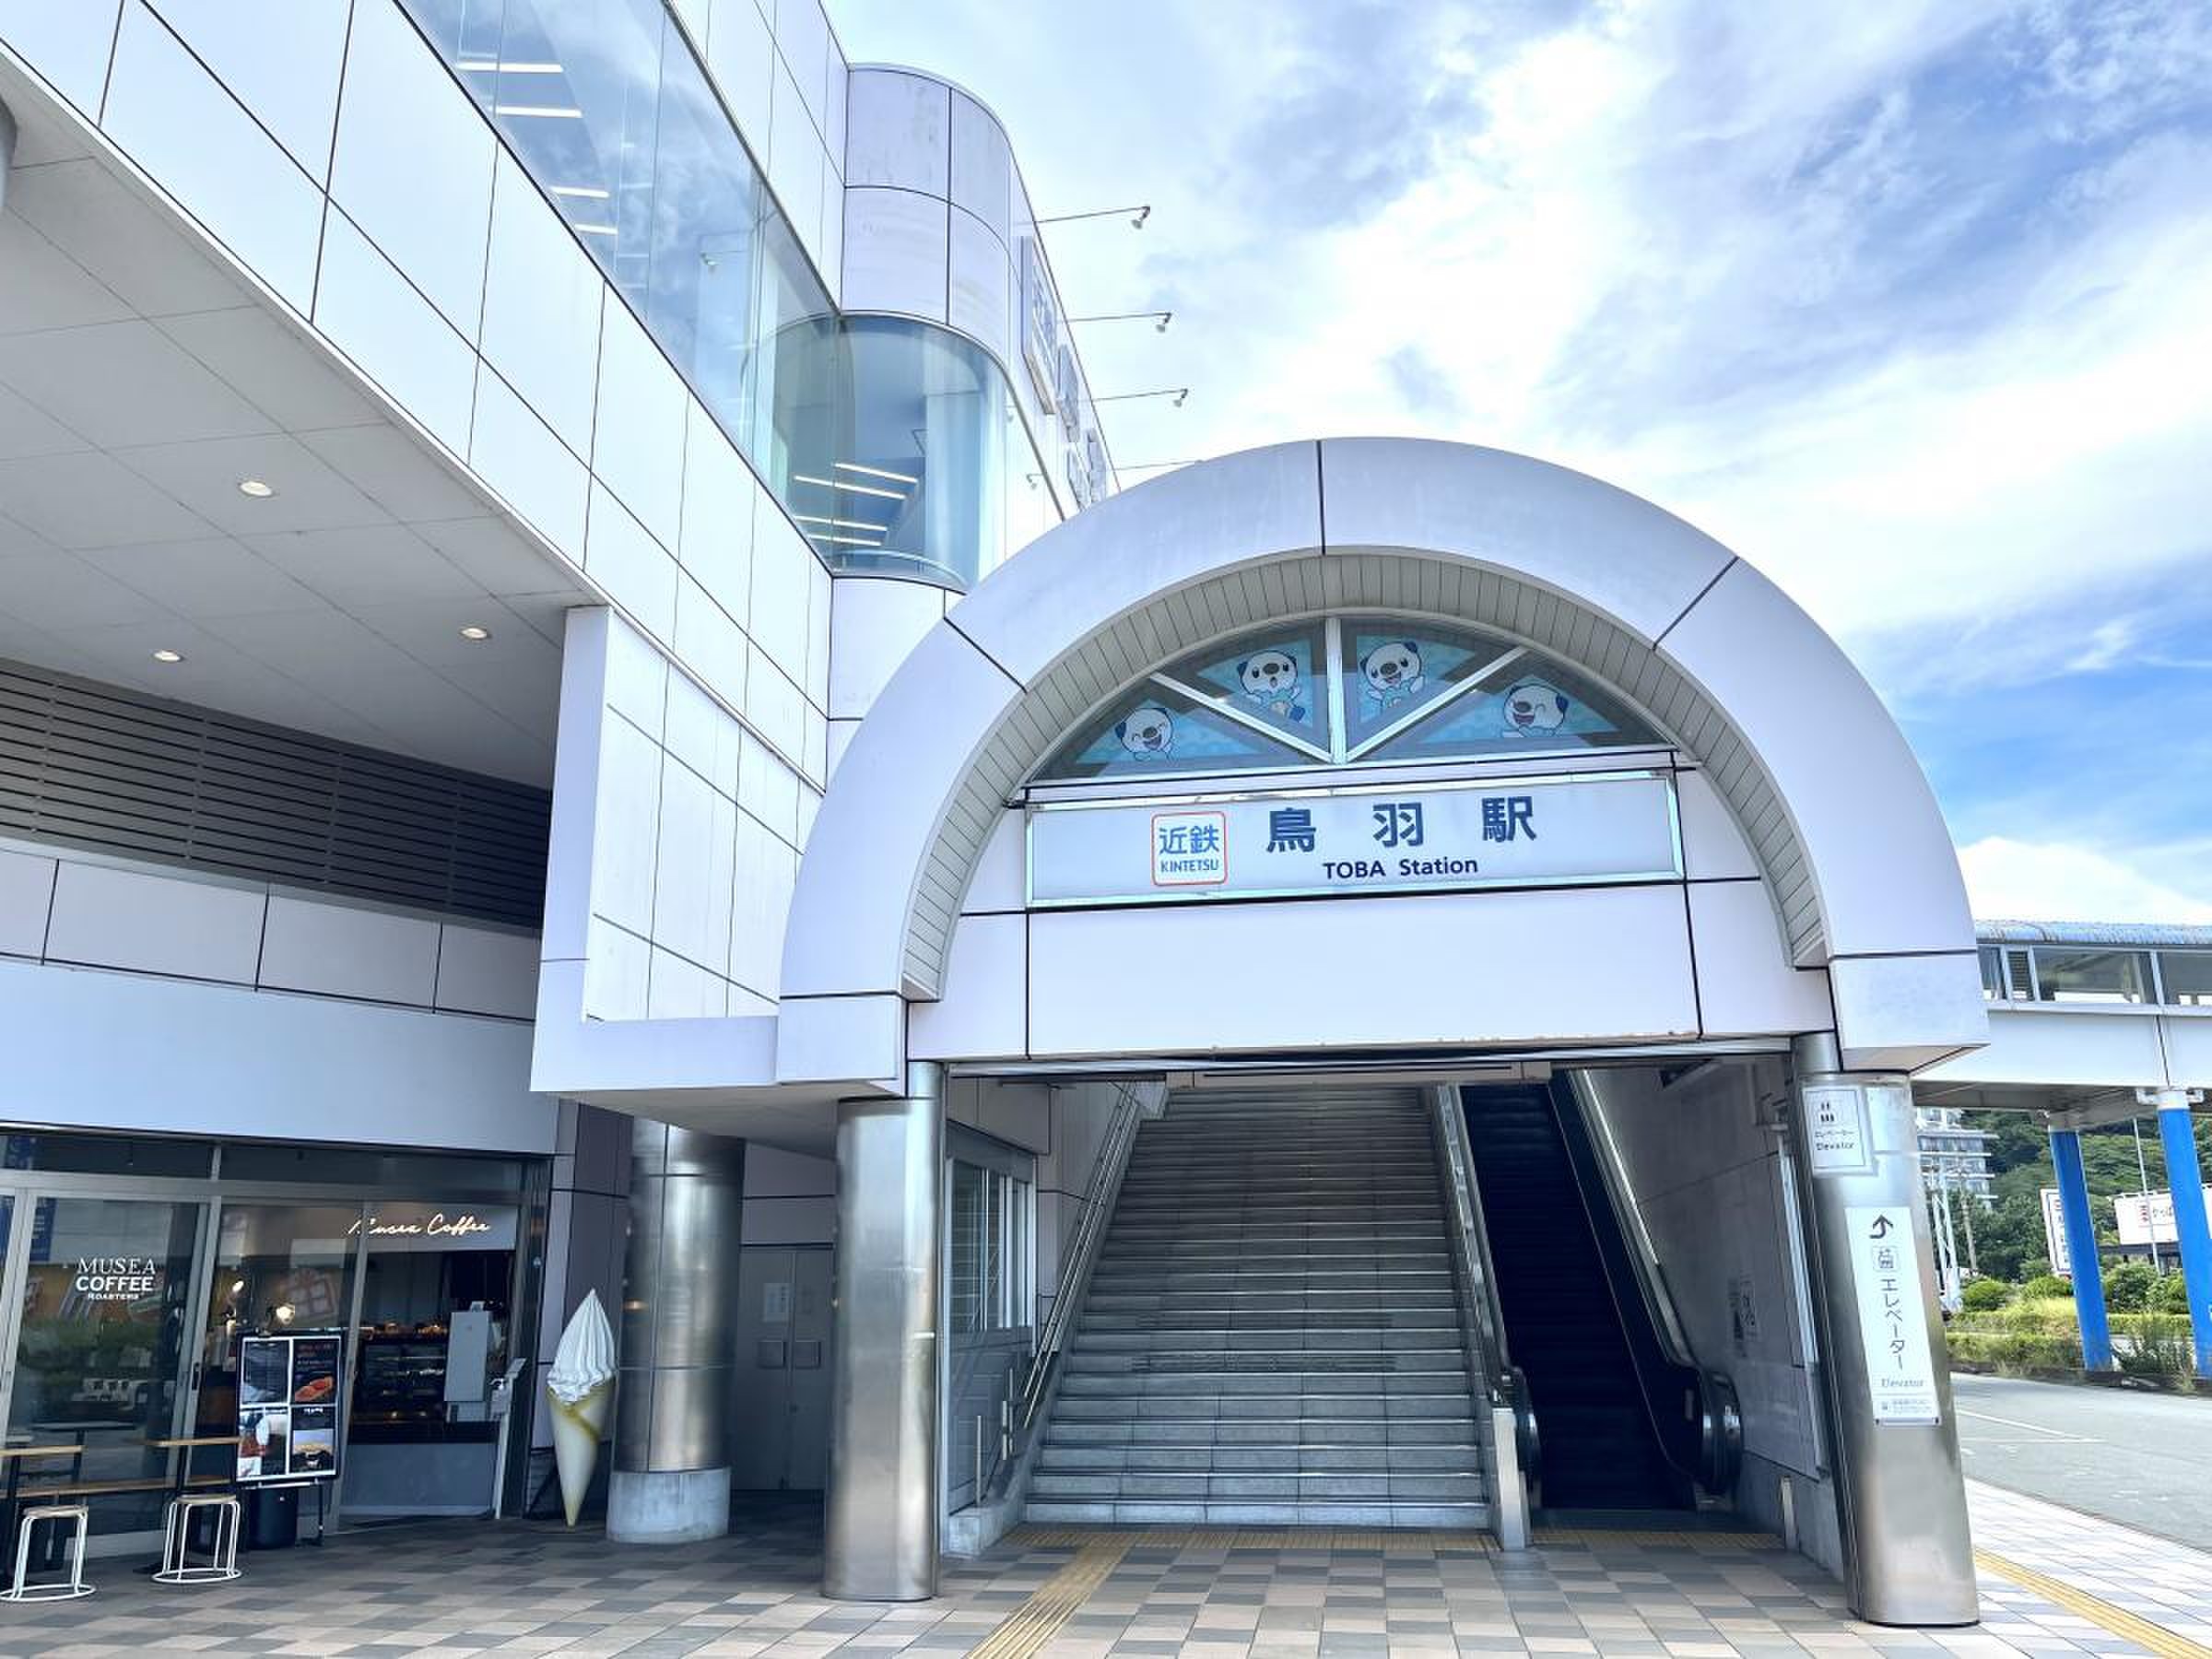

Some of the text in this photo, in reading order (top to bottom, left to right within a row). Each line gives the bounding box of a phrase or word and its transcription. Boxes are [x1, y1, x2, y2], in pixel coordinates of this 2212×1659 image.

[1266, 795, 1537, 853] 鳥羽駅
[1159, 823, 1219, 854] 近鉄
[1160, 859, 1219, 873] KINTETSU
[1323, 855, 1478, 880] TOBA Station
[427, 1212, 491, 1237] Coffee
[76, 1257, 157, 1275] MUSEA
[76, 1276, 155, 1291] COFFEE
[1880, 1277, 1906, 1371] エレベーター
